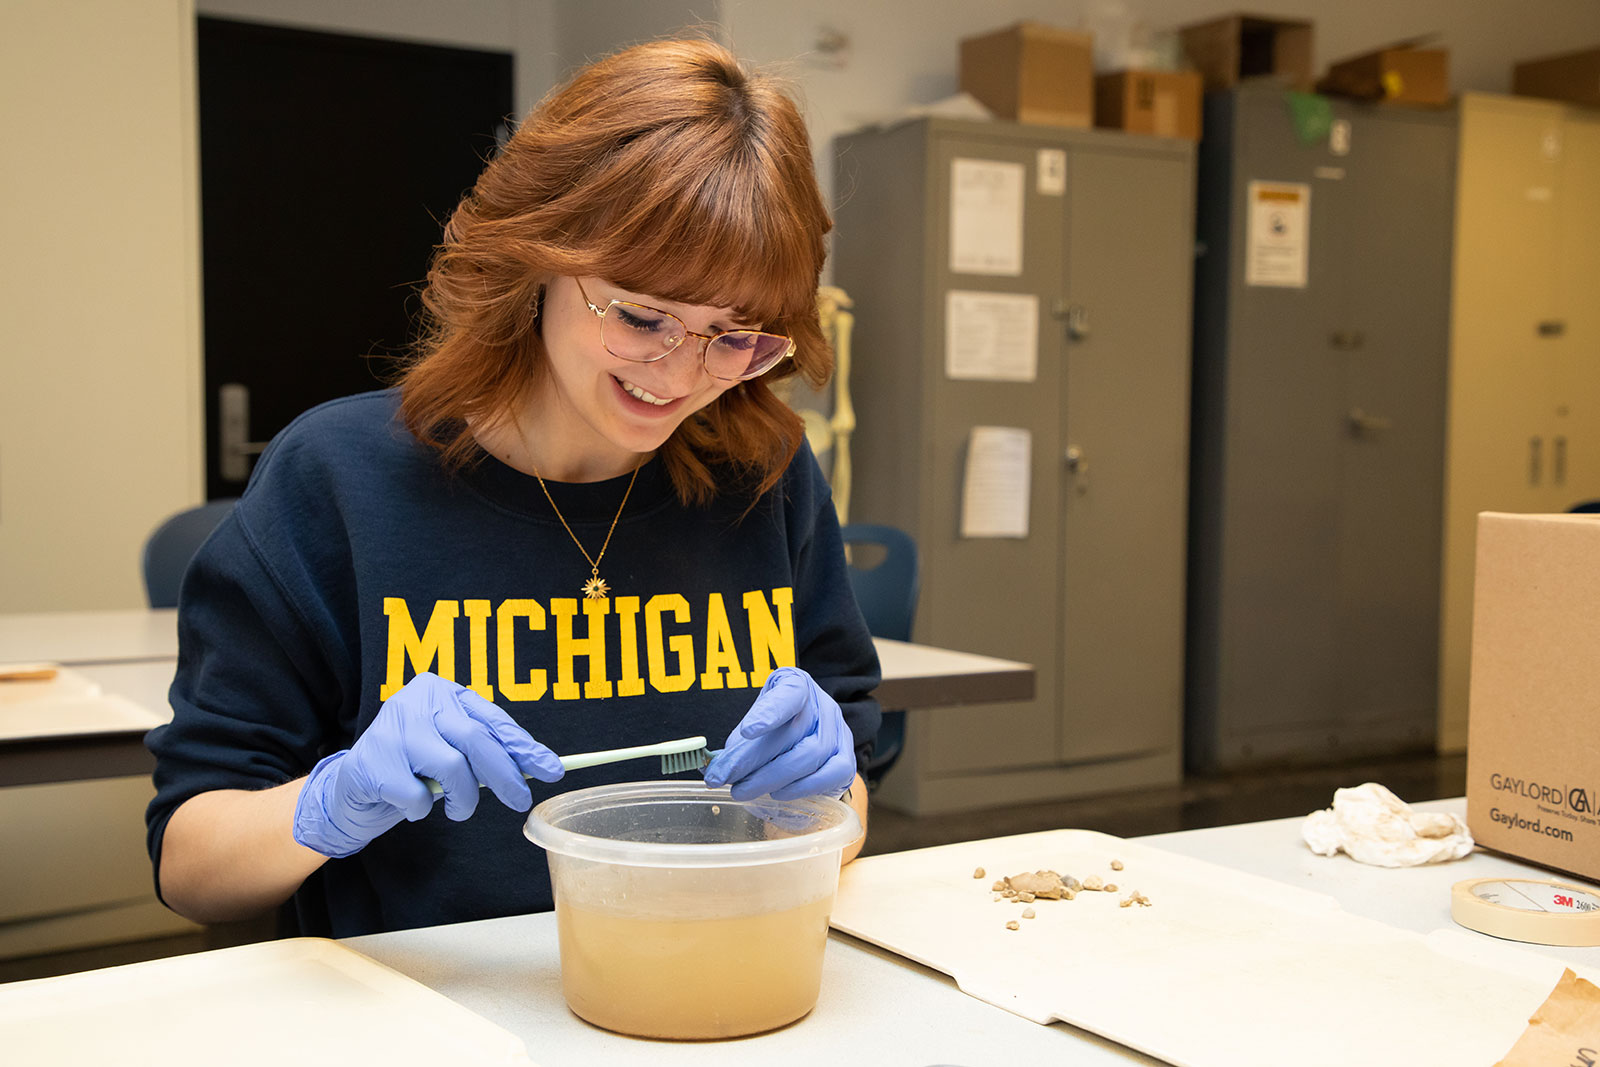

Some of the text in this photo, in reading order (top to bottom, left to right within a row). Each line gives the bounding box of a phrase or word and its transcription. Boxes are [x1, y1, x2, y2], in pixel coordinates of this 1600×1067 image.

[380, 587, 794, 702] MICHIGAN
[1490, 773, 1563, 805] GAYLORD
[1490, 807, 1573, 842] Gaylord.com
[1553, 894, 1573, 908] 3M
